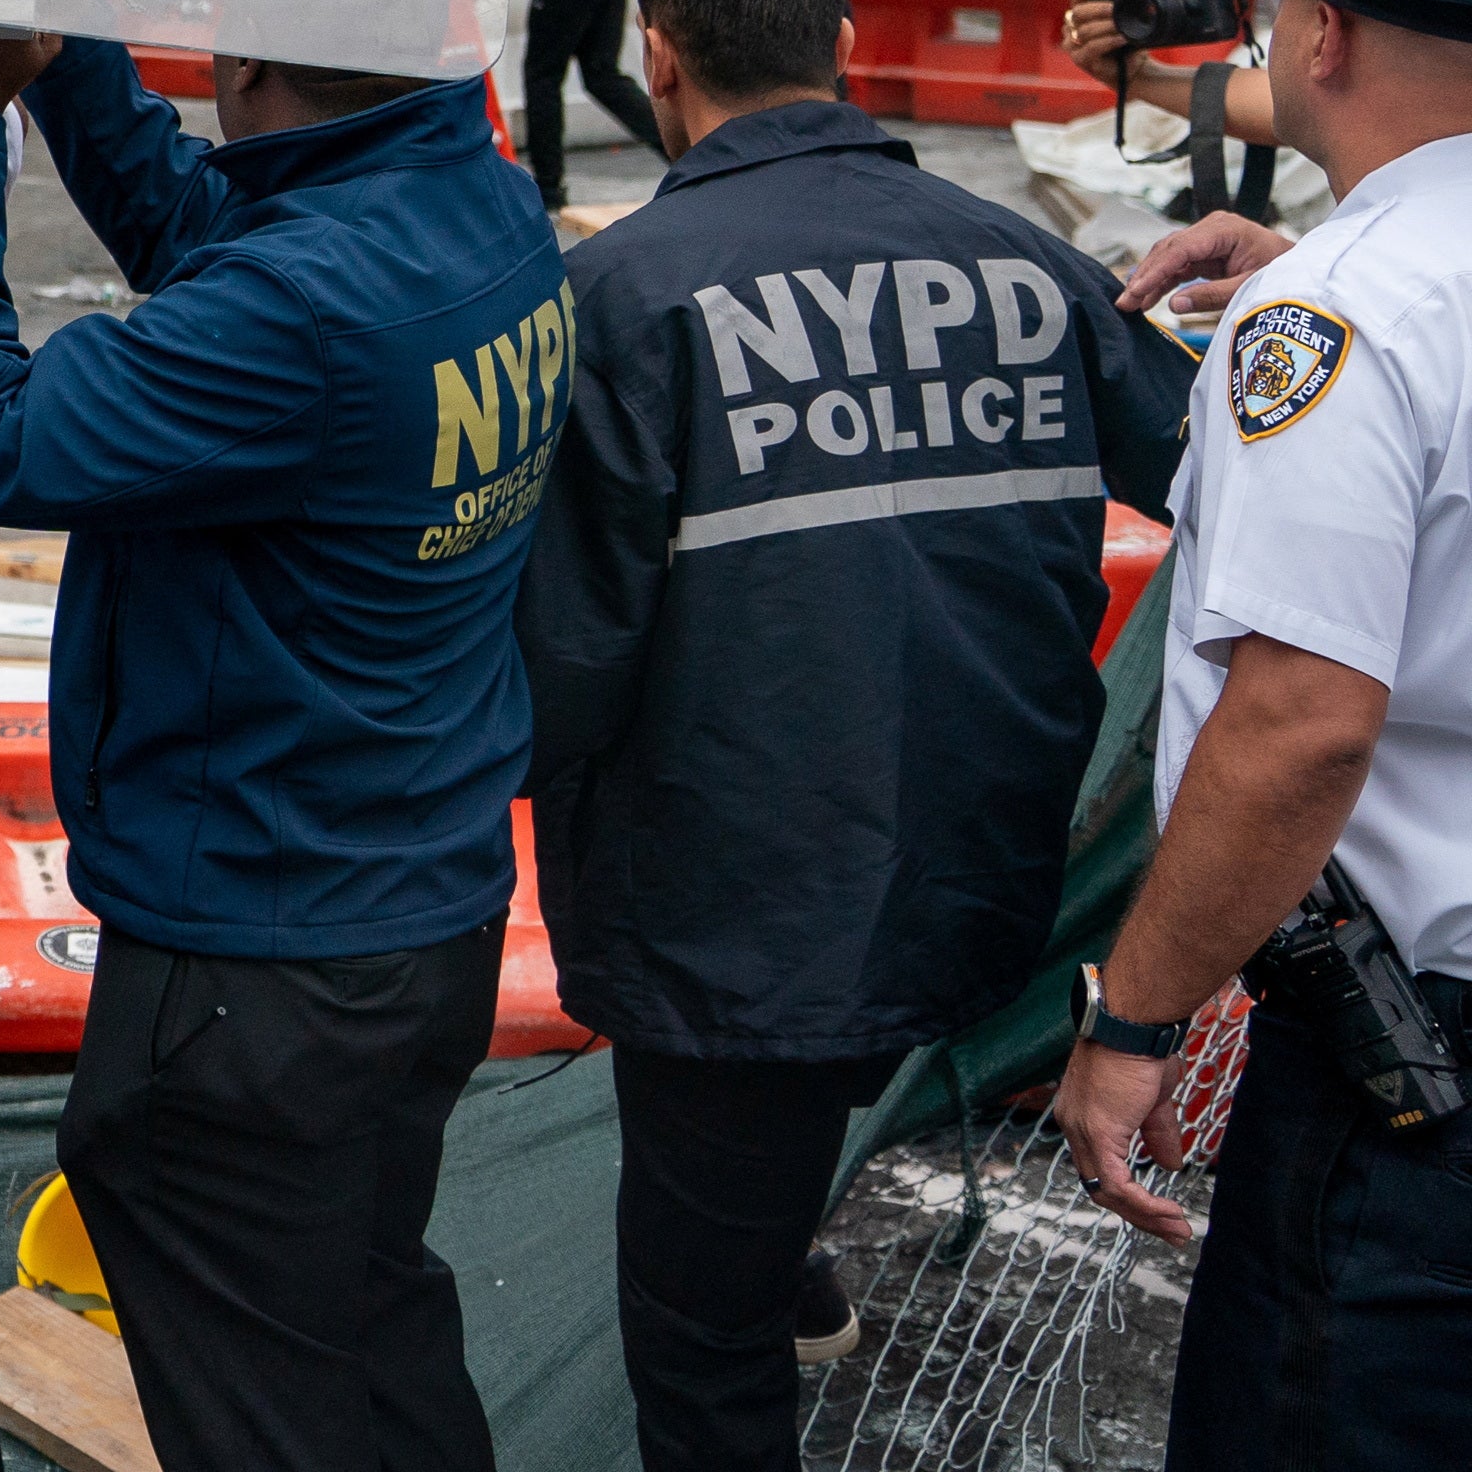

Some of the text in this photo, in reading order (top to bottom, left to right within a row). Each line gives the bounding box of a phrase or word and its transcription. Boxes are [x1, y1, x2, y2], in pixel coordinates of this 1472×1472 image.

[692, 258, 1068, 397] NYPD
[1236, 319, 1335, 354] DEPARTMENT
[1257, 306, 1313, 327] POLICE
[726, 376, 1066, 475] POLICE
[1260, 365, 1330, 426] NEW YORK
[454, 435, 553, 525] OFFICE OF
[418, 515, 493, 561] CHIEF
[485, 499, 514, 541] OF
